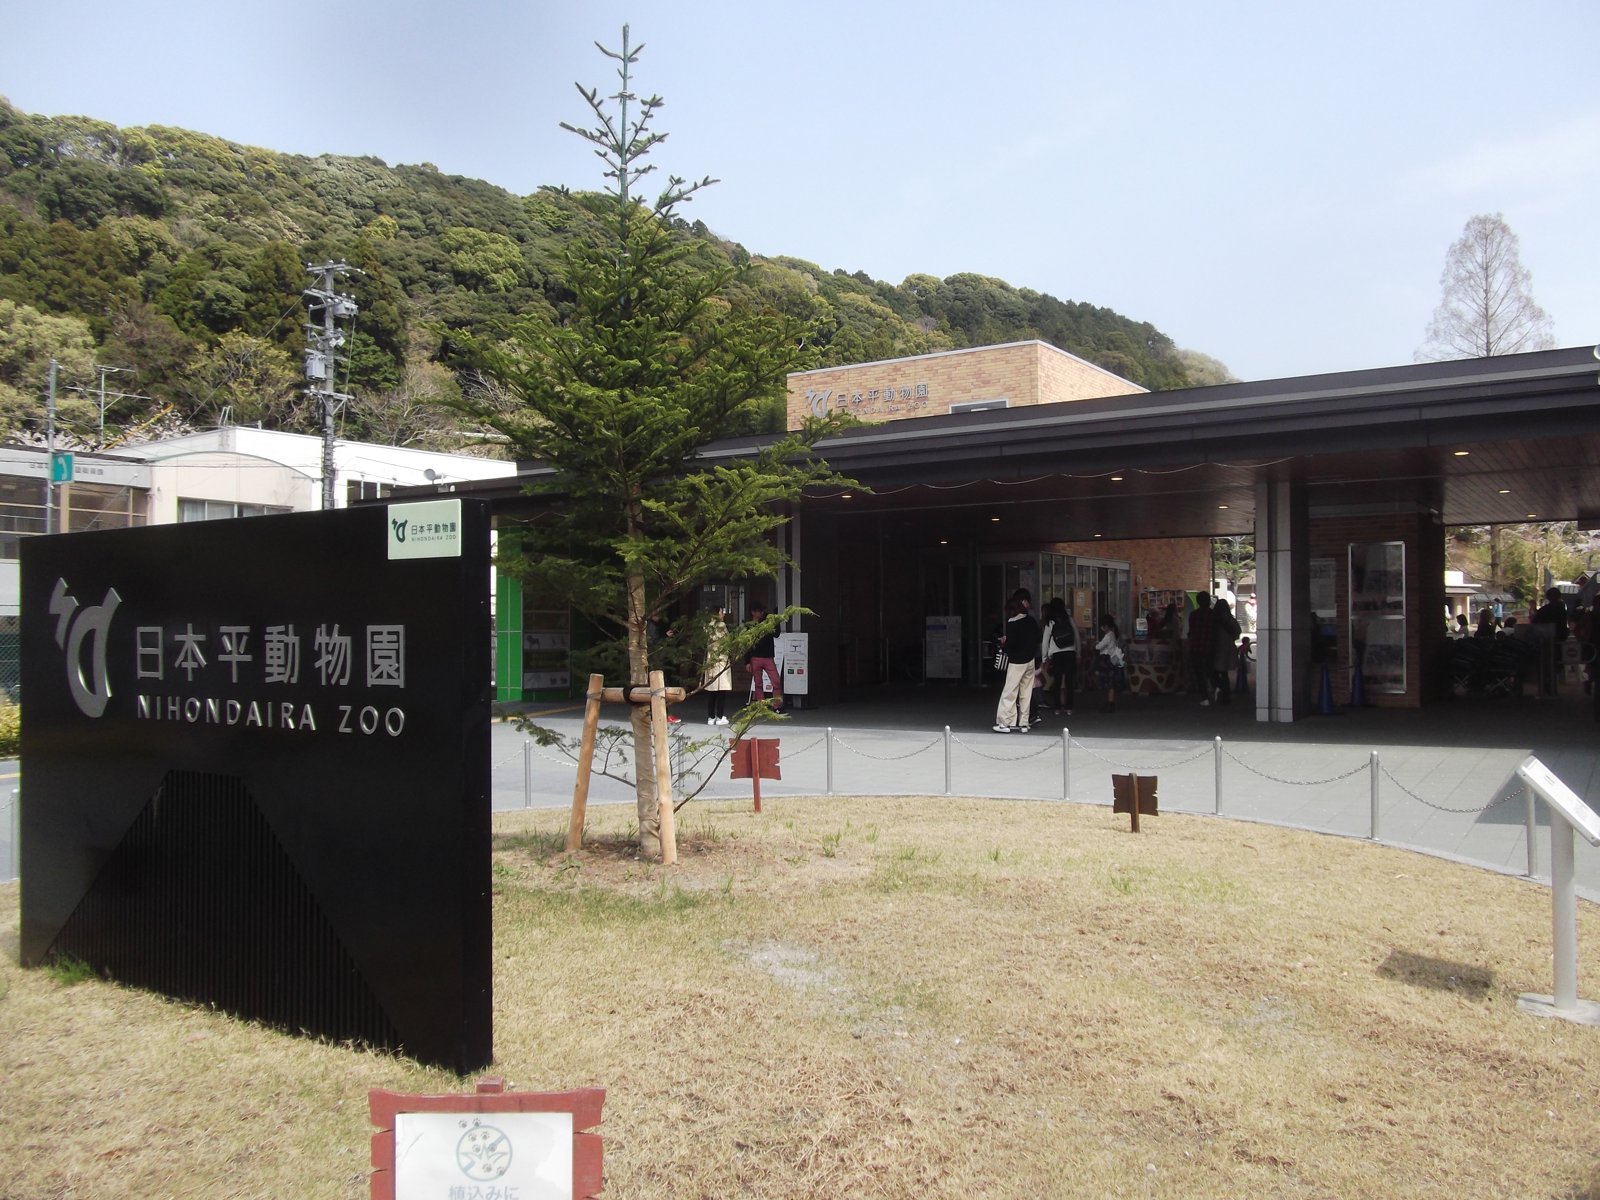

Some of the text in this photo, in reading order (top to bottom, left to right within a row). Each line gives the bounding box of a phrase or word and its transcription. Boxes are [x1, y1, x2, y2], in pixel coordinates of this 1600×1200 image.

[836, 384, 928, 408] 日本平動物園
[411, 522, 457, 535] 日本平動物園
[136, 623, 405, 688] 日本平動物園
[137, 695, 405, 737] NIHONDAIRA ZOO
[448, 1186, 520, 1200] 植込みに
